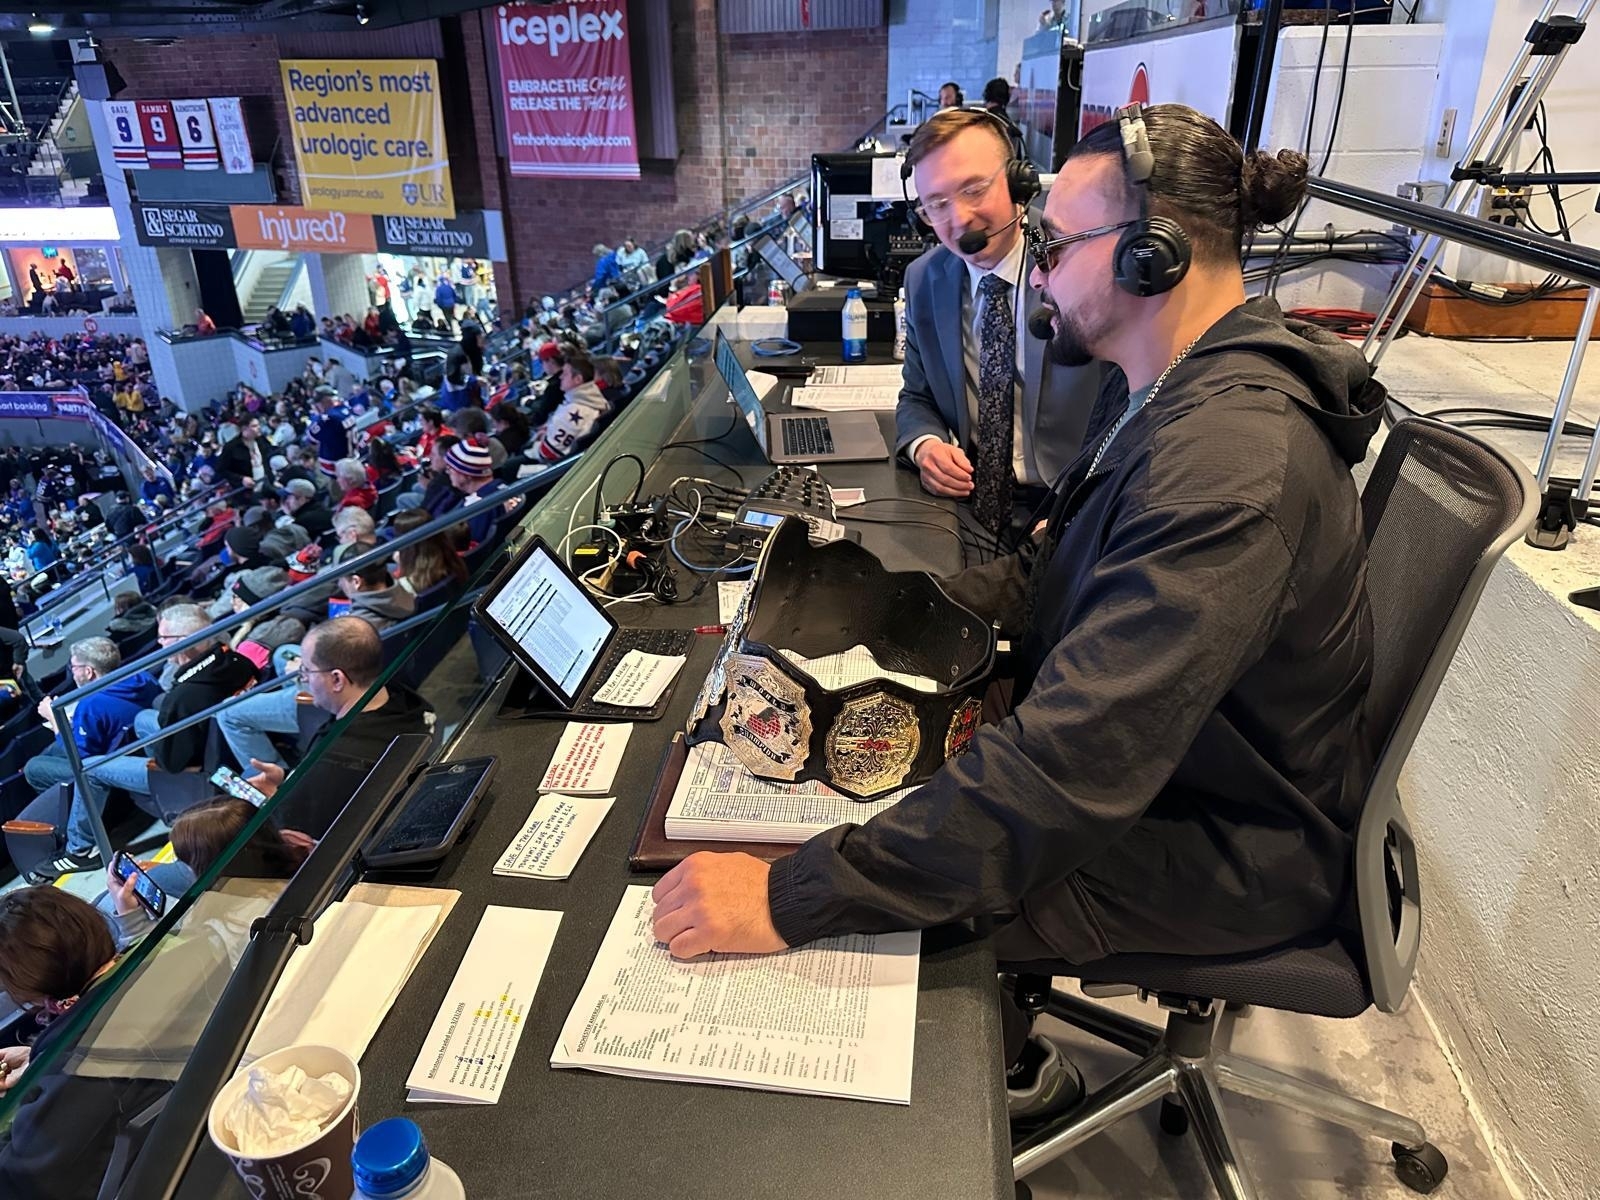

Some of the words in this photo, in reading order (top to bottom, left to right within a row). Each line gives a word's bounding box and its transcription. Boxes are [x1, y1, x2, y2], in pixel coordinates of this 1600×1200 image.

[498, 6, 624, 57] iceplex
[289, 69, 374, 97] Region's
[379, 70, 433, 93] most
[508, 80, 565, 94] EMBRACE
[565, 79, 588, 93] THE
[589, 76, 626, 92] CHILL
[141, 105, 168, 113] GAMBLE
[294, 102, 391, 125] advanced
[510, 97, 558, 111] RELEASE
[558, 97, 581, 110] THE
[582, 95, 627, 112] THRILL
[115, 116, 133, 143] 9
[150, 116, 167, 142] 9
[187, 115, 203, 142] 6
[301, 133, 376, 162] urologic
[384, 138, 433, 159] care.
[513, 132, 631, 150] timhortonsiceplex.com
[419, 183, 446, 201] UR
[162, 208, 199, 223] SEGAR
[406, 217, 446, 230] SEGAR
[165, 223, 224, 238] SCIORTINO
[258, 210, 346, 249] Injured?
[407, 231, 473, 247] SCIORTINO
[14, 402, 47, 412] banking
[554, 428, 575, 447] 26
[749, 680, 786, 711] WORLD
[740, 728, 777, 761] CHAMPION
[503, 854, 517, 867] SAVE
[527, 821, 539, 833] GAME
[535, 832, 547, 844] SAVE
[577, 1024, 591, 1052] ROCHESTER
[428, 1053, 443, 1079] Milestones
[439, 1035, 450, 1052] headed
